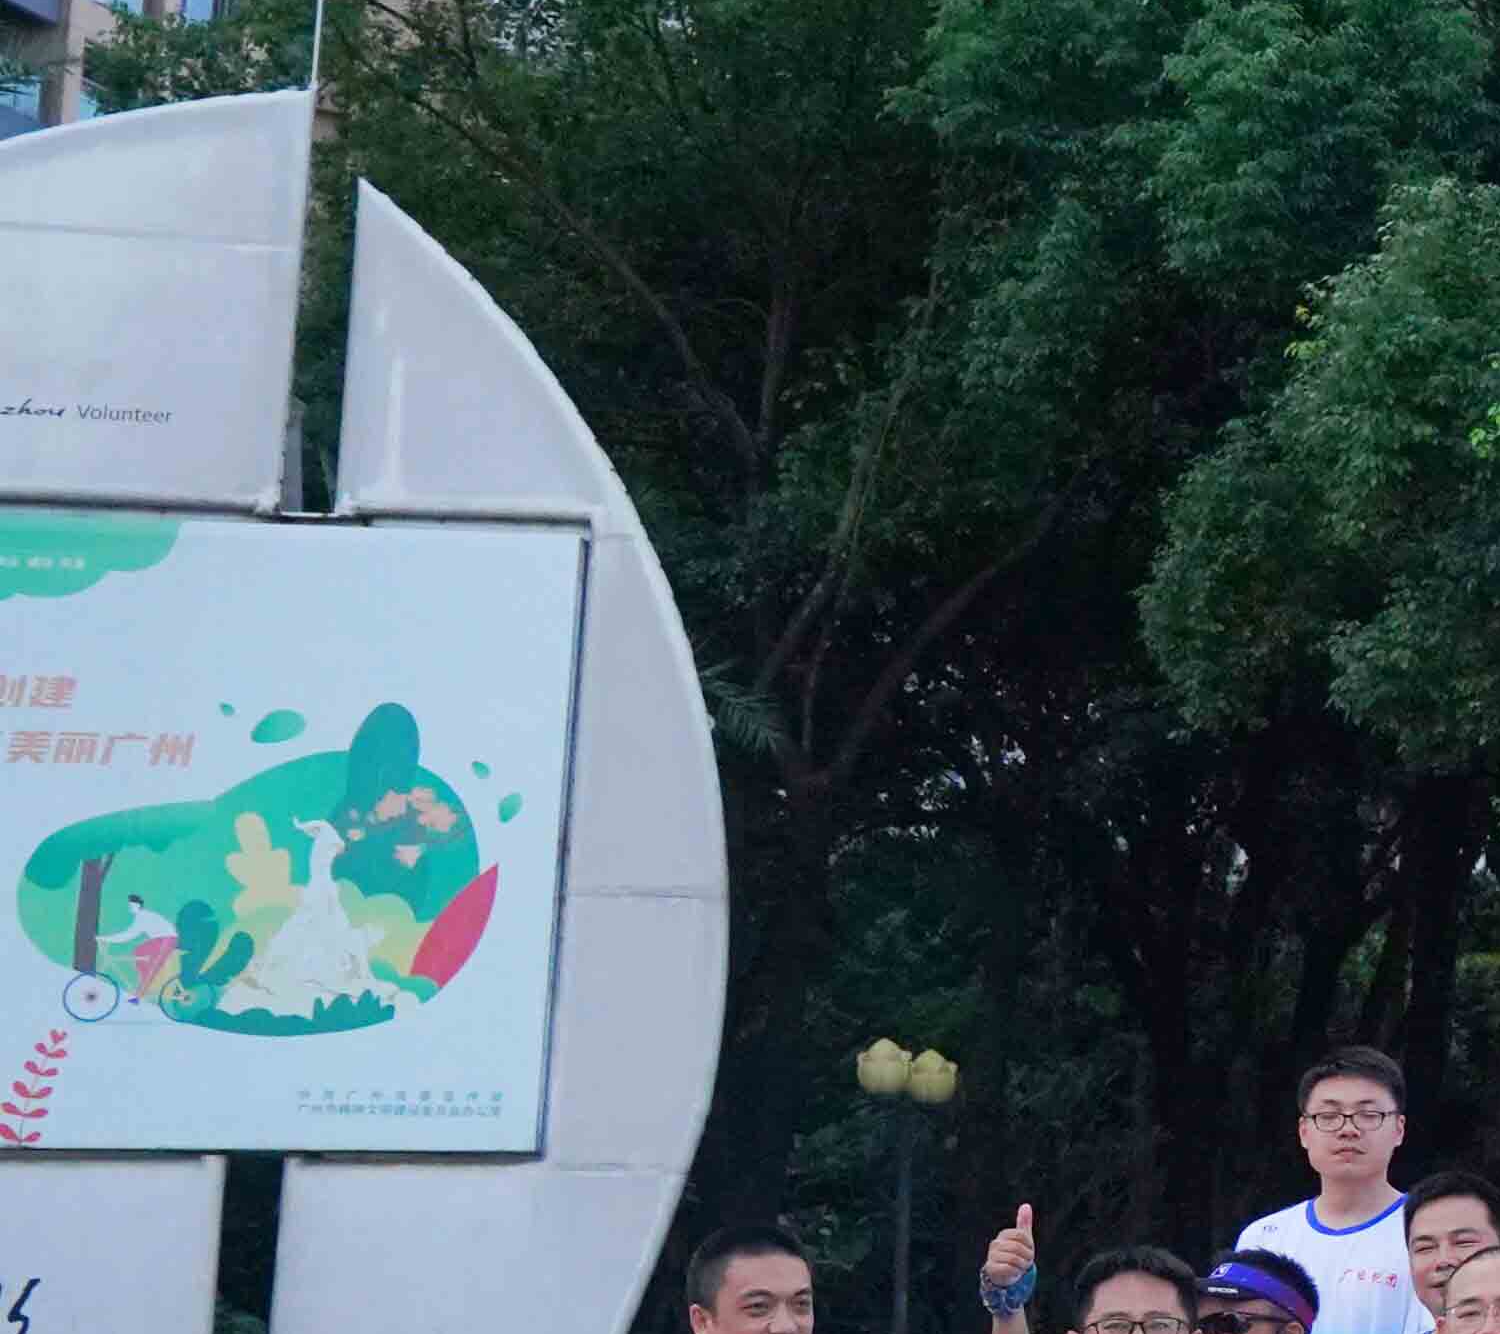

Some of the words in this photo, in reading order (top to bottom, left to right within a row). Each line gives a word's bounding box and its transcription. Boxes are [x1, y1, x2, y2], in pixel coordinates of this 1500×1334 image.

[77, 402, 172, 424] Volunteer
[6, 730, 196, 767] 美丽广州
